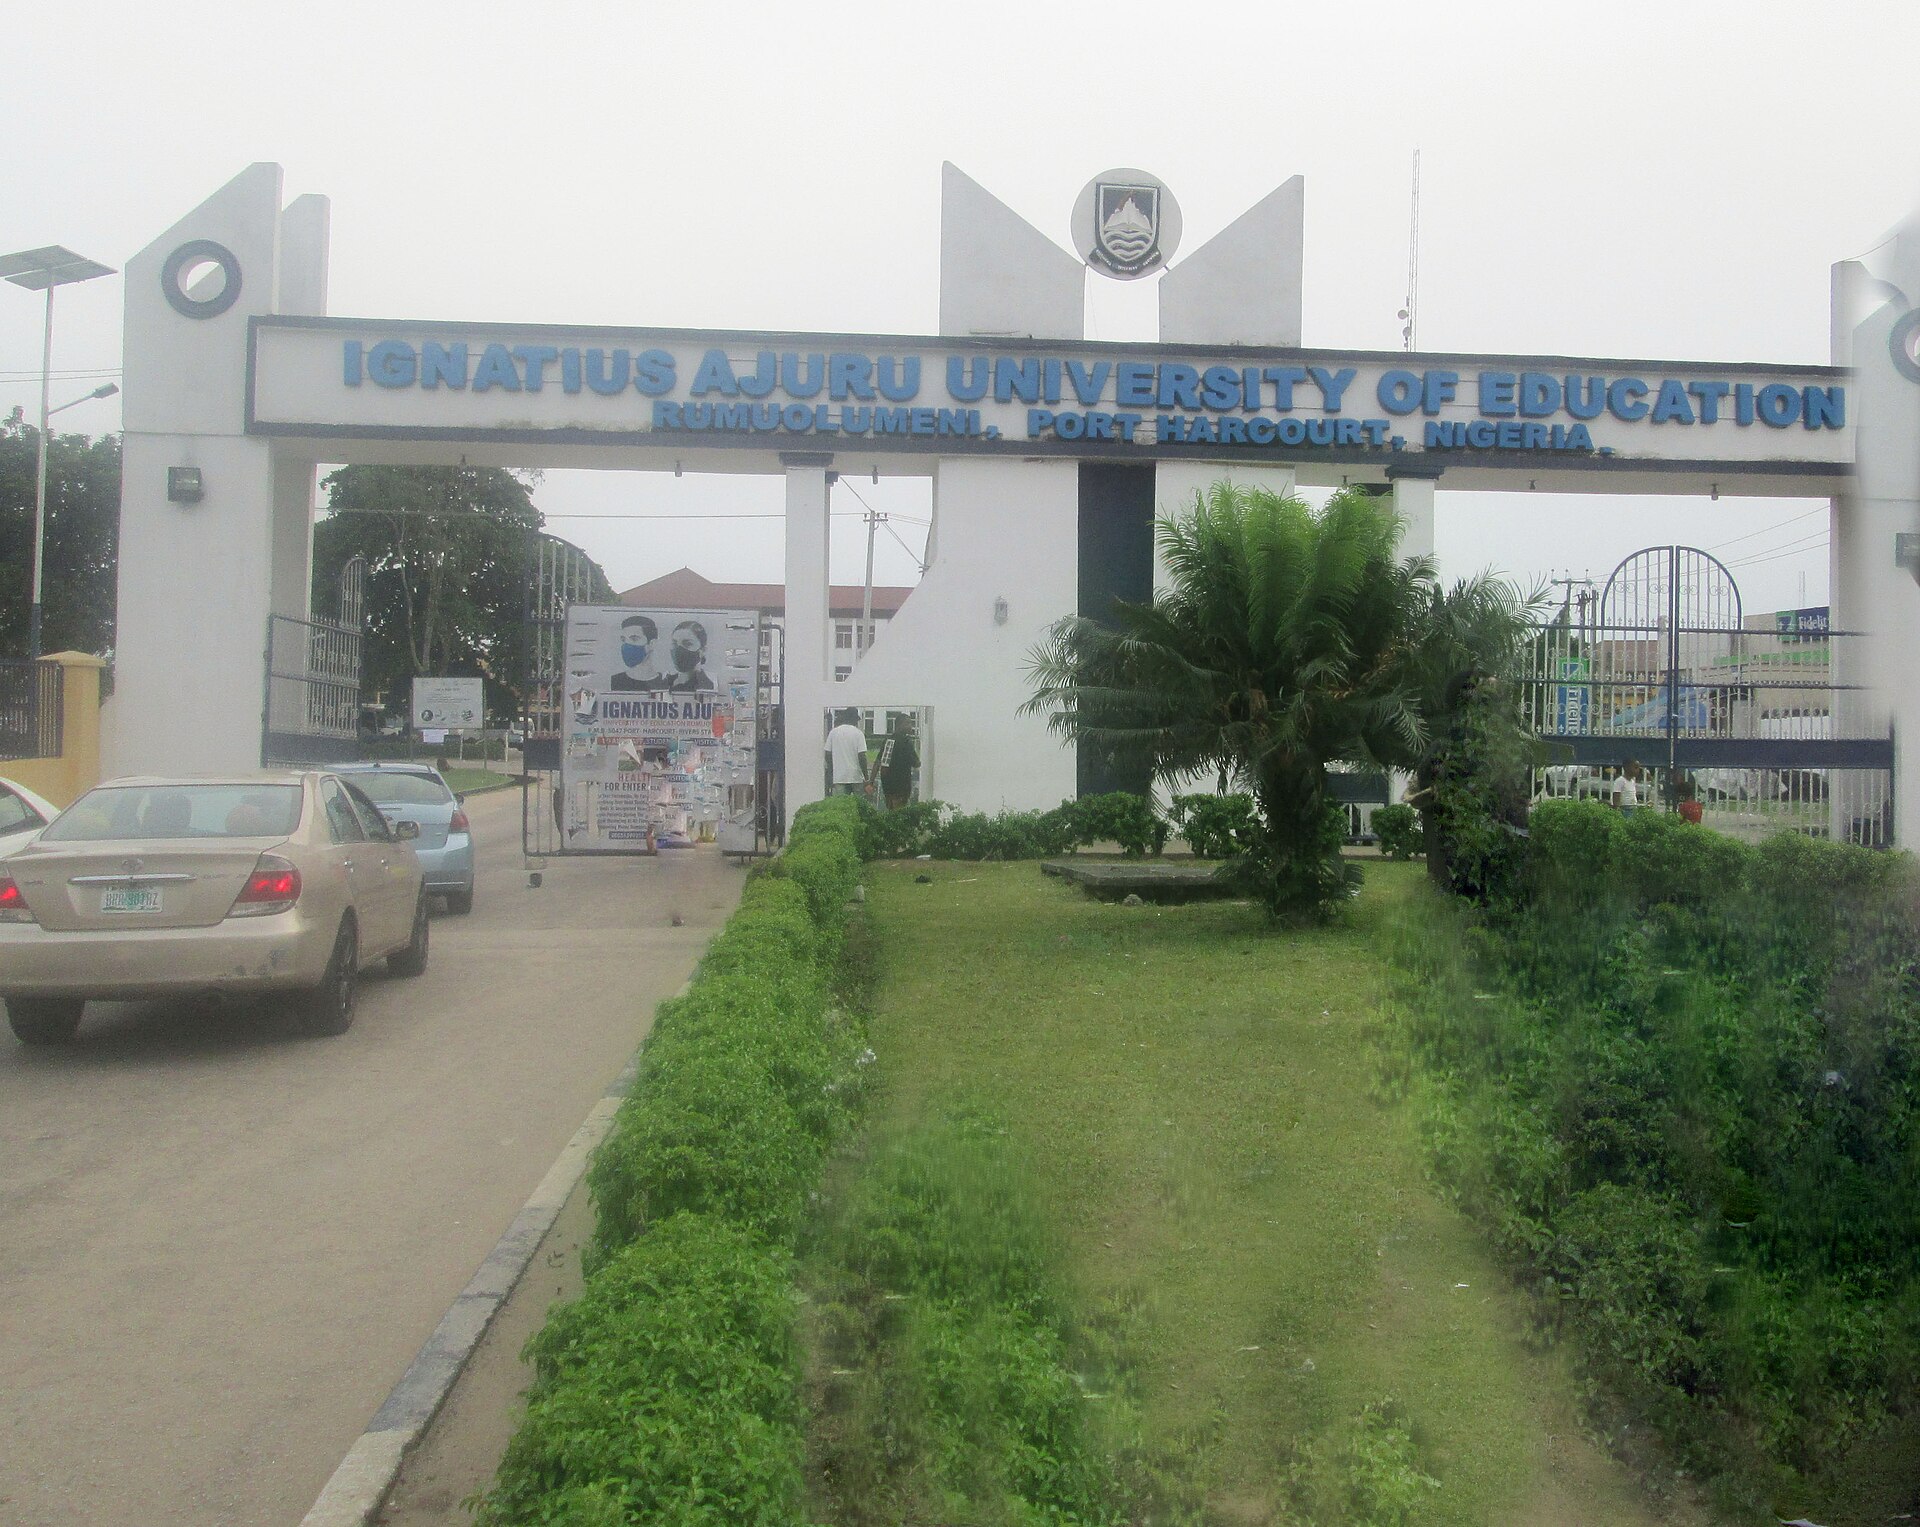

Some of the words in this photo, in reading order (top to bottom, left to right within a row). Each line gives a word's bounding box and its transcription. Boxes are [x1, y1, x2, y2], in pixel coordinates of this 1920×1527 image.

[343, 339, 677, 396] IGNATIUS
[690, 348, 921, 401] AJURU
[946, 355, 1358, 413] UNIVERSITY
[1377, 370, 1459, 416] OF
[1478, 371, 1846, 430] EDUCATION
[652, 400, 1003, 440] RUMUOLUMENI,
[1027, 408, 1142, 439] PORT
[1156, 413, 1408, 450] HARCOURT,
[602, 701, 679, 719] IGNATIUS
[682, 703, 712, 719] AJU
[618, 773, 650, 782] HEALT
[605, 783, 619, 791] FOR
[622, 783, 647, 791] ENTER
